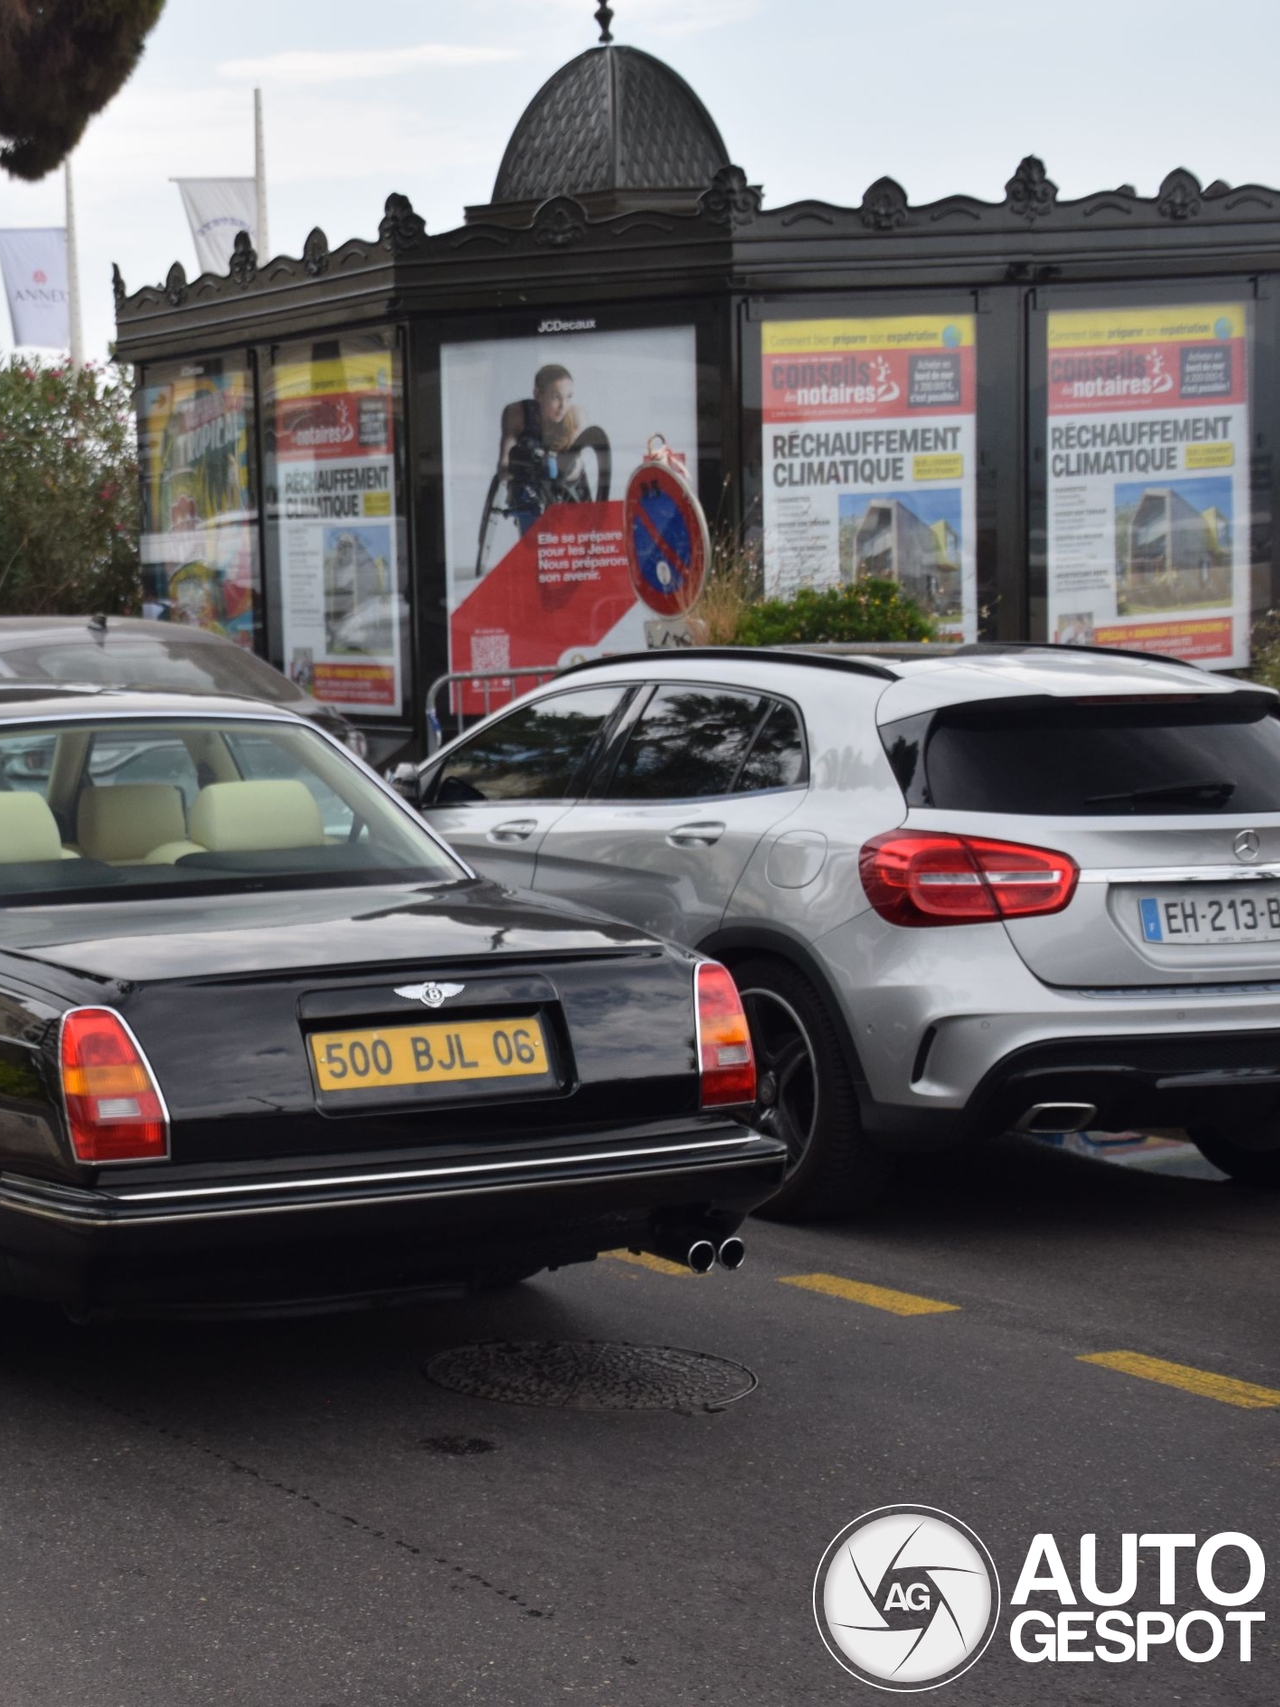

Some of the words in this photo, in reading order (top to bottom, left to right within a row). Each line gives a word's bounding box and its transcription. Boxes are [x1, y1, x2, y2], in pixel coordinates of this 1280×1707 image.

[537, 319, 597, 333] JCDecaux
[1108, 325, 1144, 340] préparer
[1160, 322, 1211, 336] expatriation
[832, 332, 868, 346] préparer
[887, 330, 939, 344] expatriation
[771, 356, 871, 390] conseils
[914, 370, 931, 381] bord
[941, 372, 954, 380] mer
[1050, 350, 1148, 384] conseils
[796, 382, 877, 406] notaires
[1073, 375, 1152, 398] notaires
[296, 425, 343, 447] notaires
[772, 426, 962, 460] RÉCHAUFFEMENT
[1051, 416, 1233, 450] RÉCHAUFFEMENT
[772, 457, 905, 489] CLIMATIQUE
[1051, 446, 1178, 479] CLIMATIQUE
[284, 465, 390, 494] RÉCHAUFFEMENT
[285, 494, 360, 520] CLIMATIQUE
[537, 532, 559, 545] Elle
[561, 534, 576, 544] se
[577, 528, 623, 545] prépare
[537, 547, 566, 560] pour
[567, 545, 586, 556] les
[587, 543, 620, 556] Jeux.
[538, 559, 570, 571] Nous
[538, 572, 561, 584] son
[562, 569, 602, 583] avenir.
[325, 1037, 393, 1080] 500
[410, 1033, 479, 1072] BJL
[492, 1028, 536, 1066] 06
